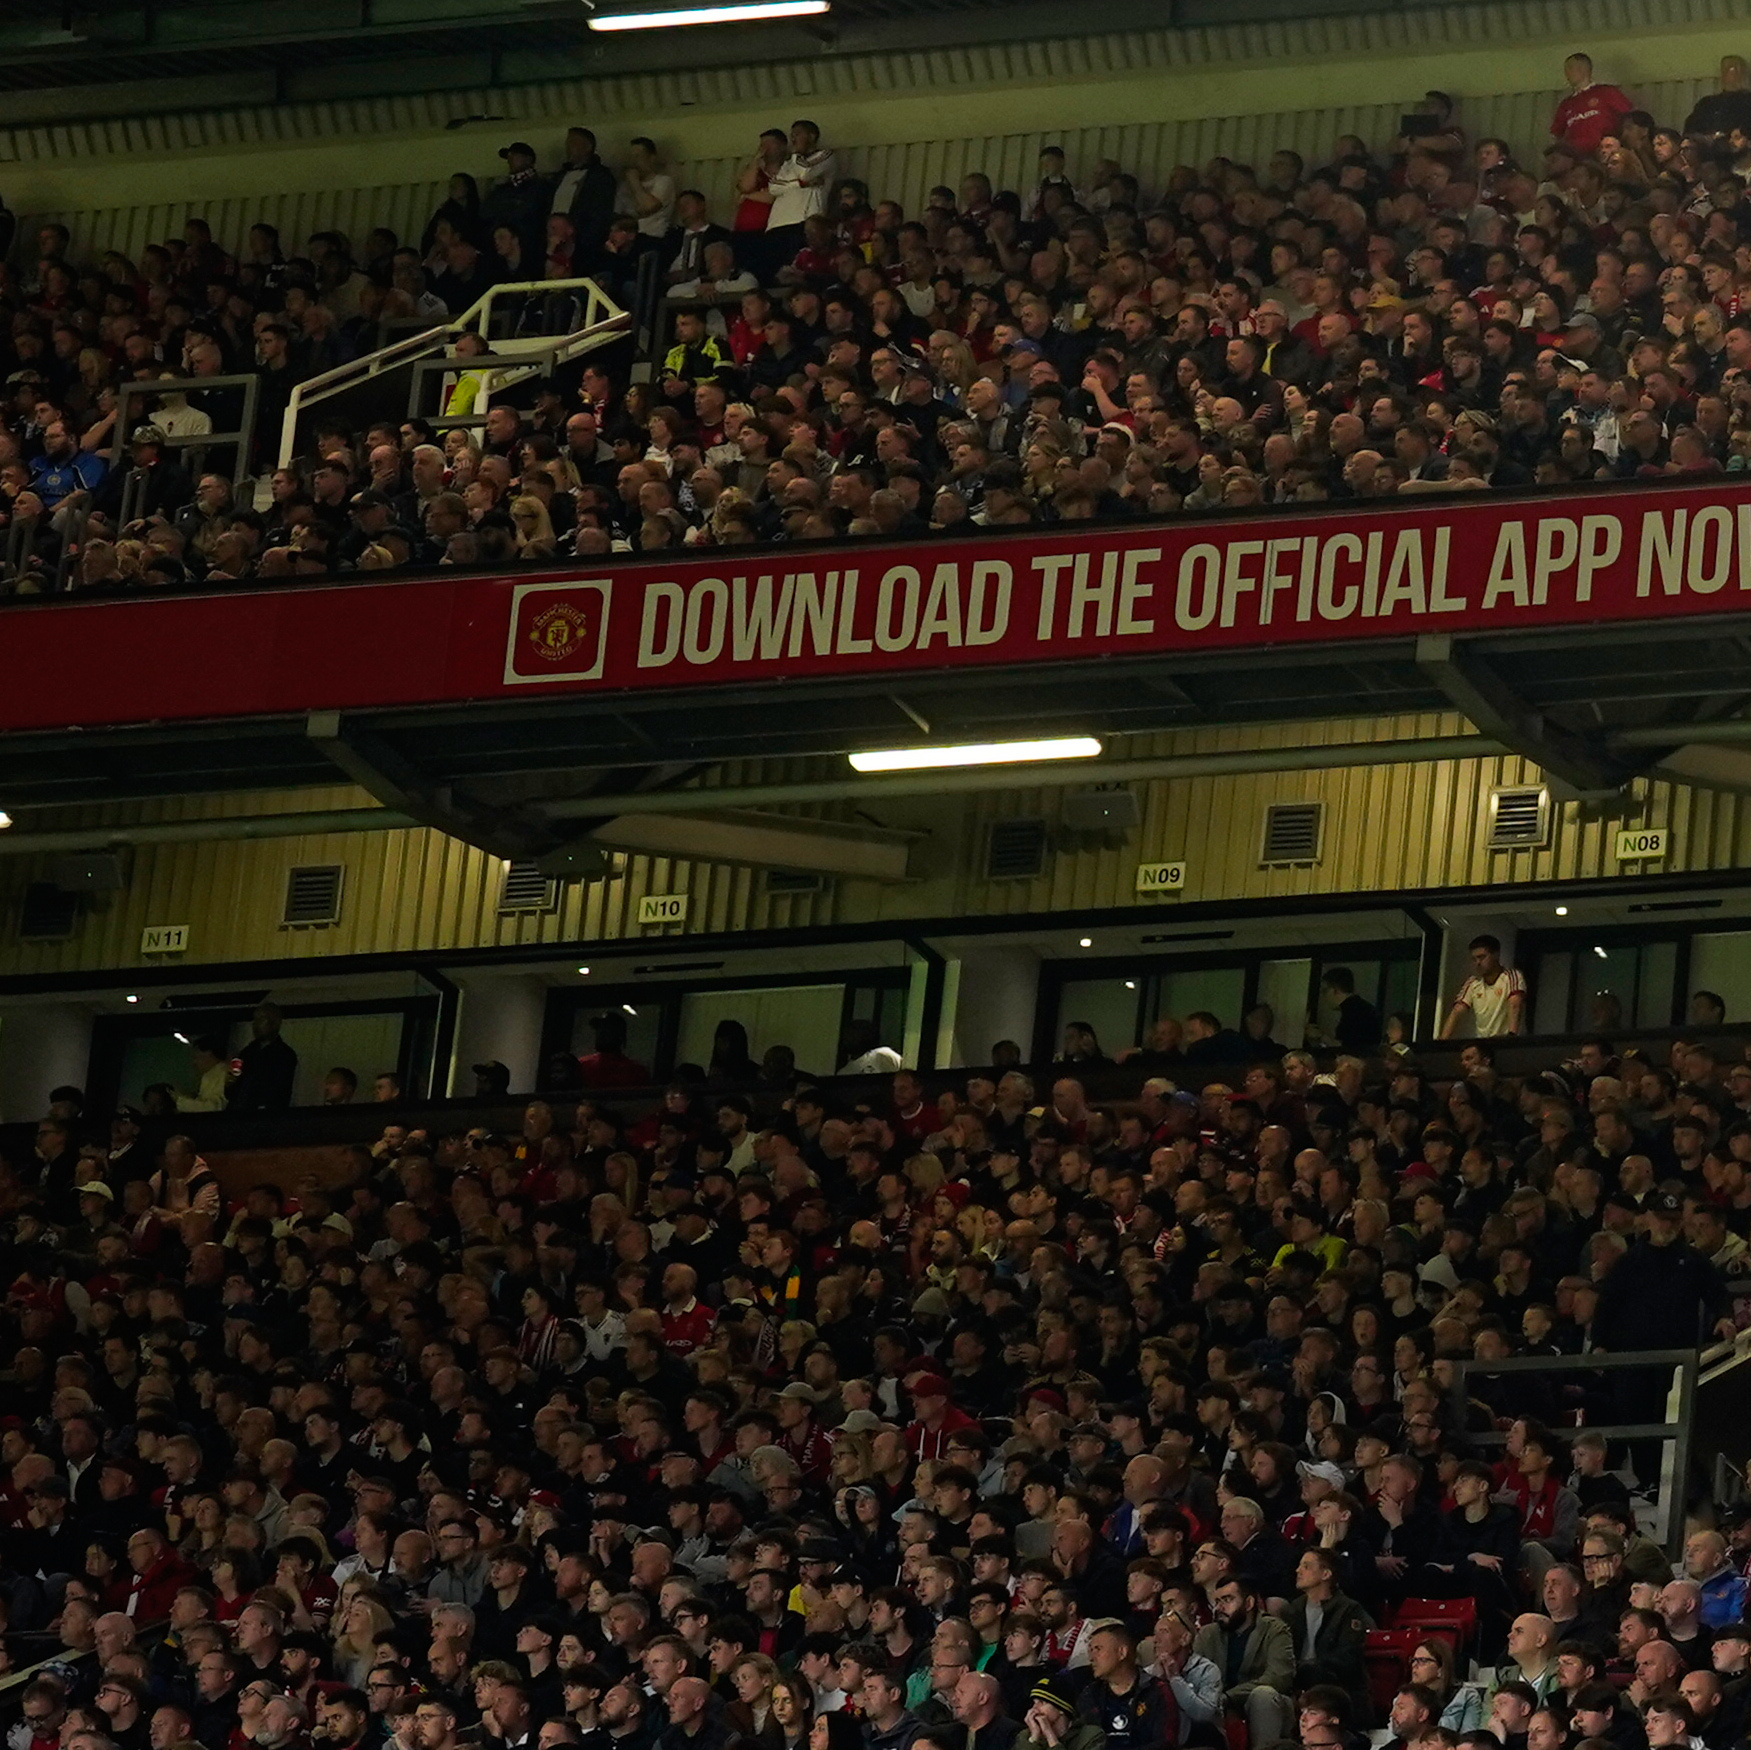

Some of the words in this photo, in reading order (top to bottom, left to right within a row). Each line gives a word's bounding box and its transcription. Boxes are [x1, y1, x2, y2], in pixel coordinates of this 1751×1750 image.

[638, 560, 1013, 667] DOWNLOAD
[1031, 548, 1162, 640] THE
[1175, 527, 1467, 630] OFFICIAL
[1482, 515, 1622, 608] APP
[1623, 835, 1660, 852] N08
[1143, 867, 1181, 885] N09
